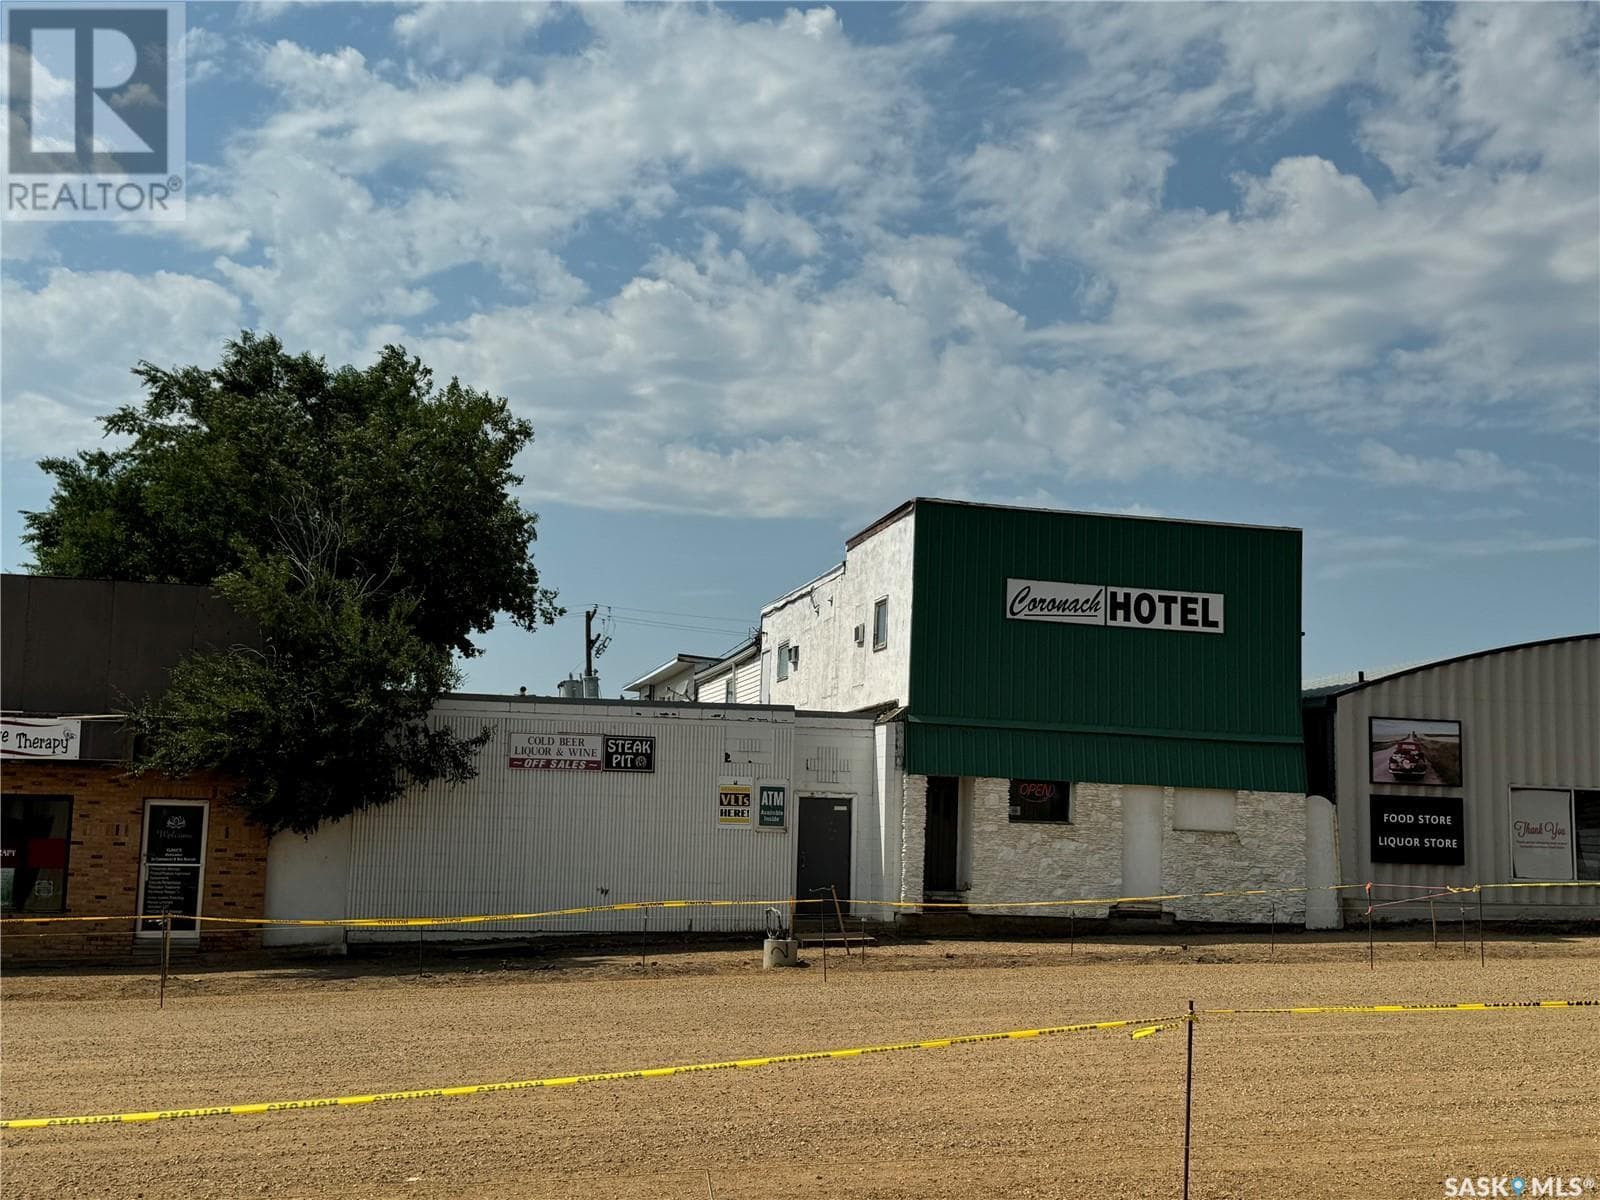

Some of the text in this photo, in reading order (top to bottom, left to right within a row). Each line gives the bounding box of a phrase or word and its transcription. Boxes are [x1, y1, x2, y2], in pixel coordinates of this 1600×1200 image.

[1009, 585, 1219, 628] Coronach HOTEL
[0, 730, 69, 754] e Therapy
[527, 736, 585, 747] COLD BEER
[607, 739, 652, 754] STEAK
[514, 746, 598, 757] LIQUOR & WINE
[524, 759, 587, 769] OFF SALES
[612, 754, 635, 768] PIT
[1019, 783, 1054, 798] OPEN
[720, 793, 750, 806] VLTs
[761, 790, 784, 806] ATM
[720, 808, 750, 818] HERE!
[1383, 813, 1452, 825] FOOD STORE
[1514, 820, 1567, 840] Thank You
[1378, 836, 1458, 848] LIQUOR STORE
